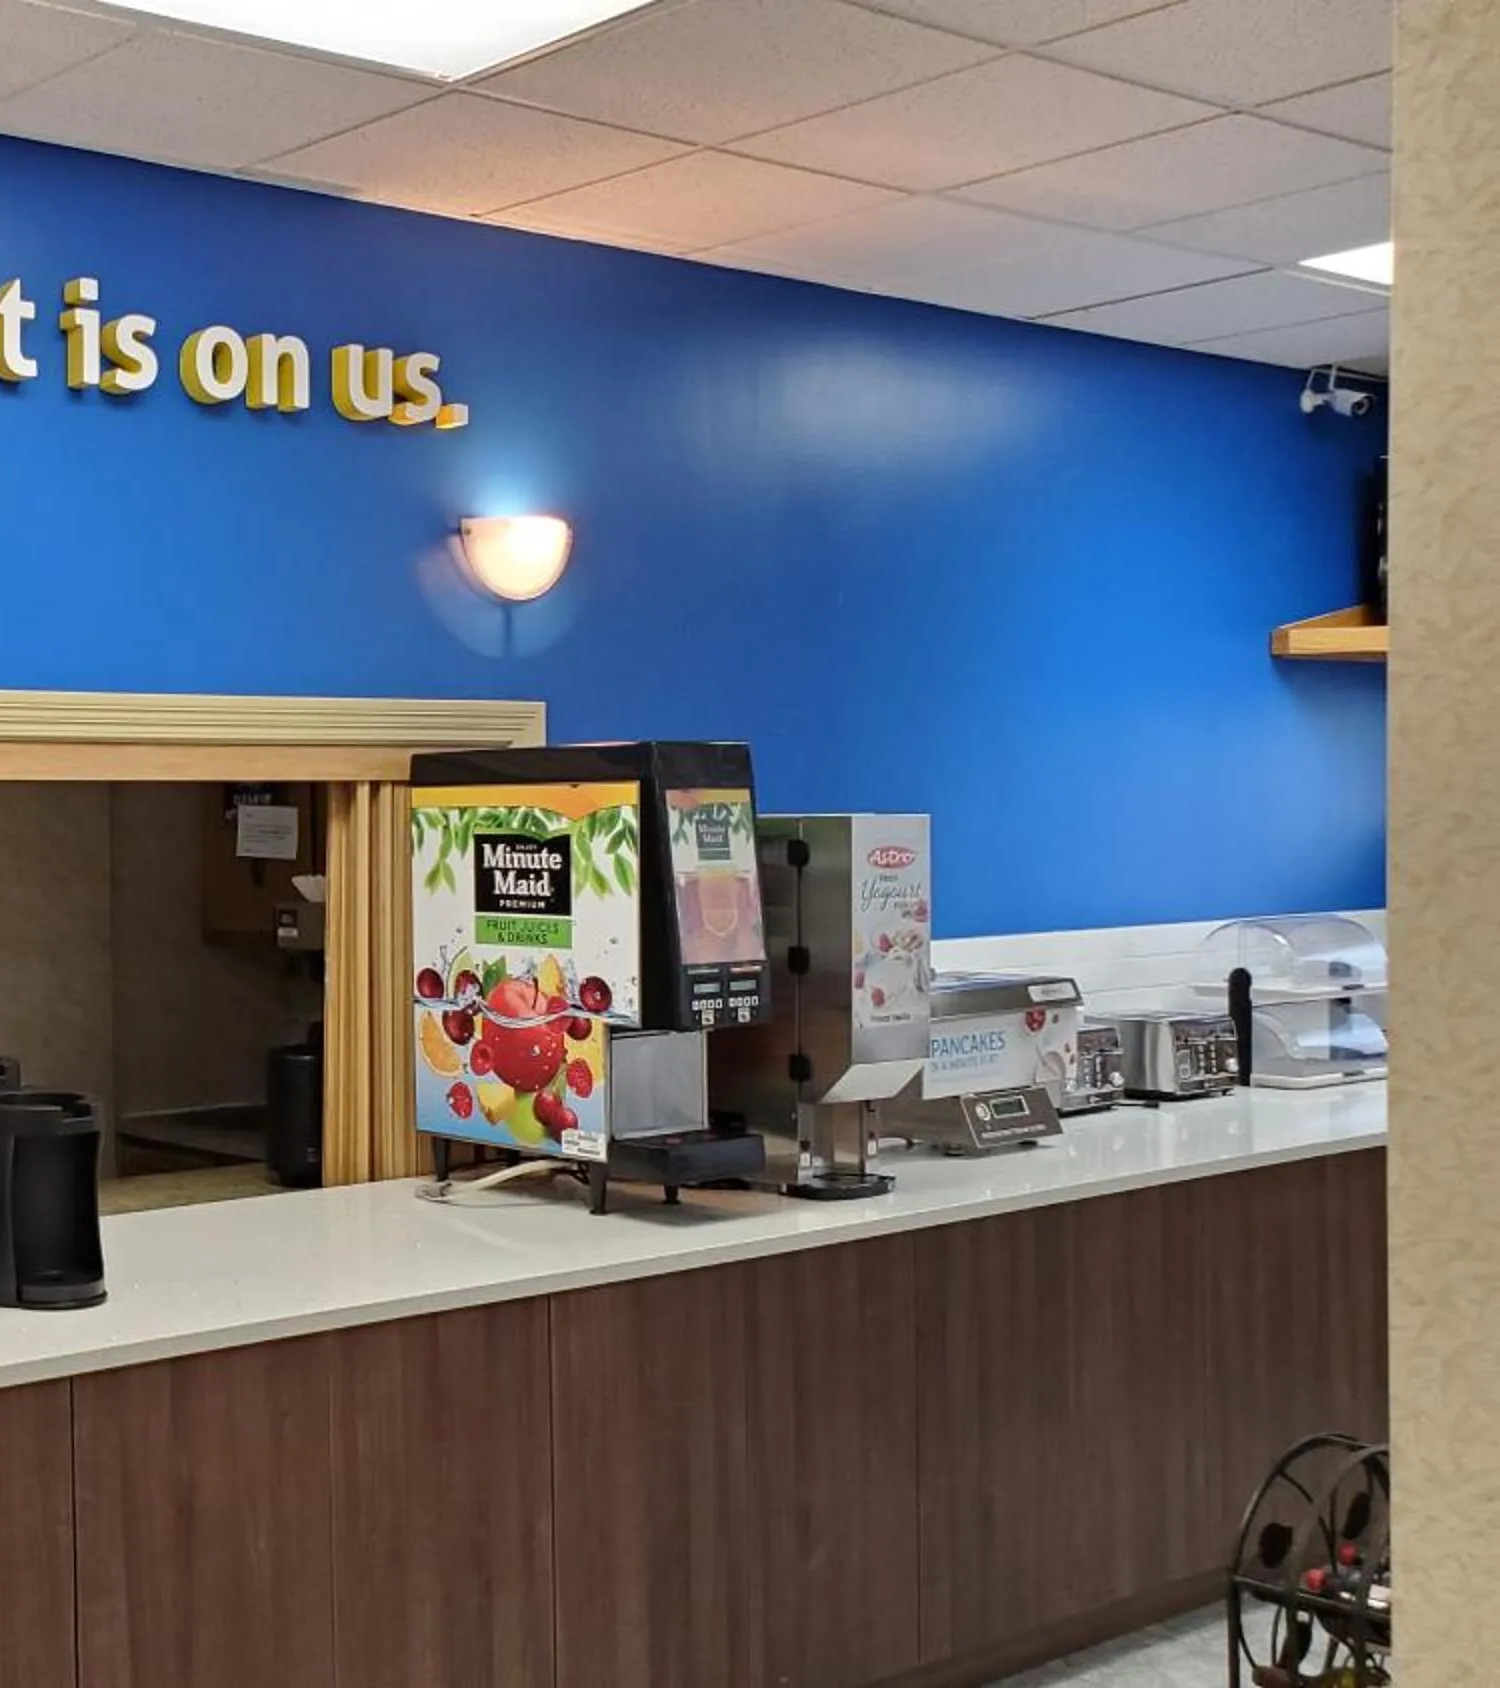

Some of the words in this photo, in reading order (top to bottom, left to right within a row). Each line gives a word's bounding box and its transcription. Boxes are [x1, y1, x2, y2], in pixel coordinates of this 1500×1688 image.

[60, 277, 158, 394] is
[180, 325, 310, 412] on
[331, 343, 469, 429] us.
[482, 843, 563, 869] Minute
[493, 870, 552, 897] Maid
[499, 899, 546, 909] PREMIUM
[486, 919, 517, 931] FRUIT
[521, 921, 559, 934] JUICES
[509, 931, 549, 945] DRINKS
[930, 1030, 1006, 1057] PANCAKES
